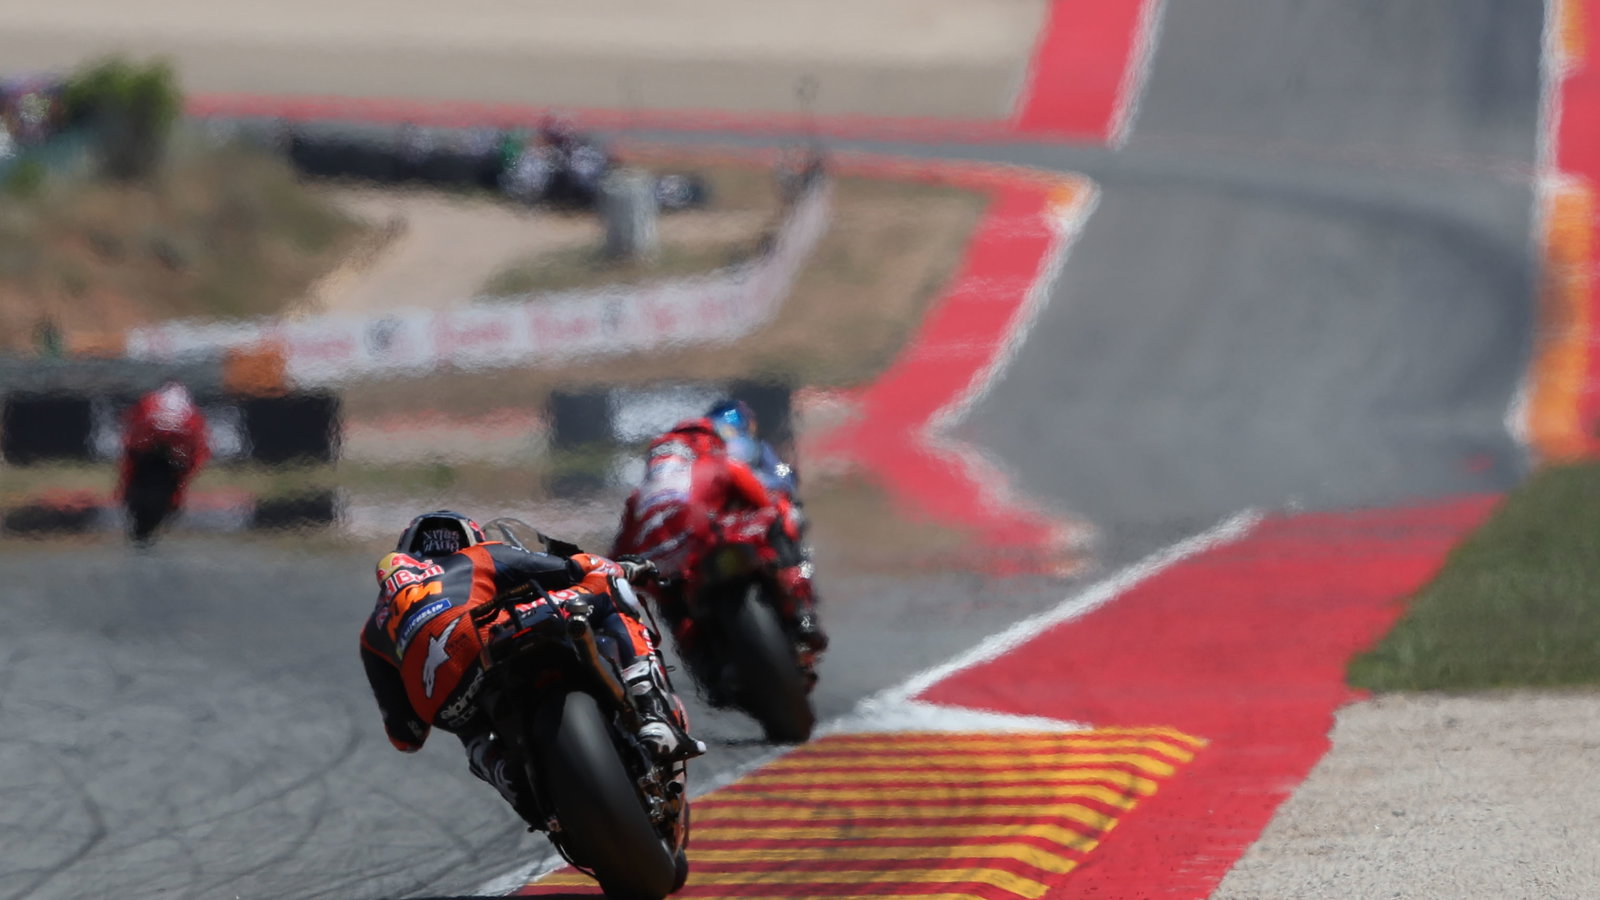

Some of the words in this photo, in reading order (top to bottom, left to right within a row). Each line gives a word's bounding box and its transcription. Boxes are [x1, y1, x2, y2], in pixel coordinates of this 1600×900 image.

[393, 565, 445, 588] Bull
[403, 602, 444, 638] MICHELIN
[440, 666, 485, 720] alpines
